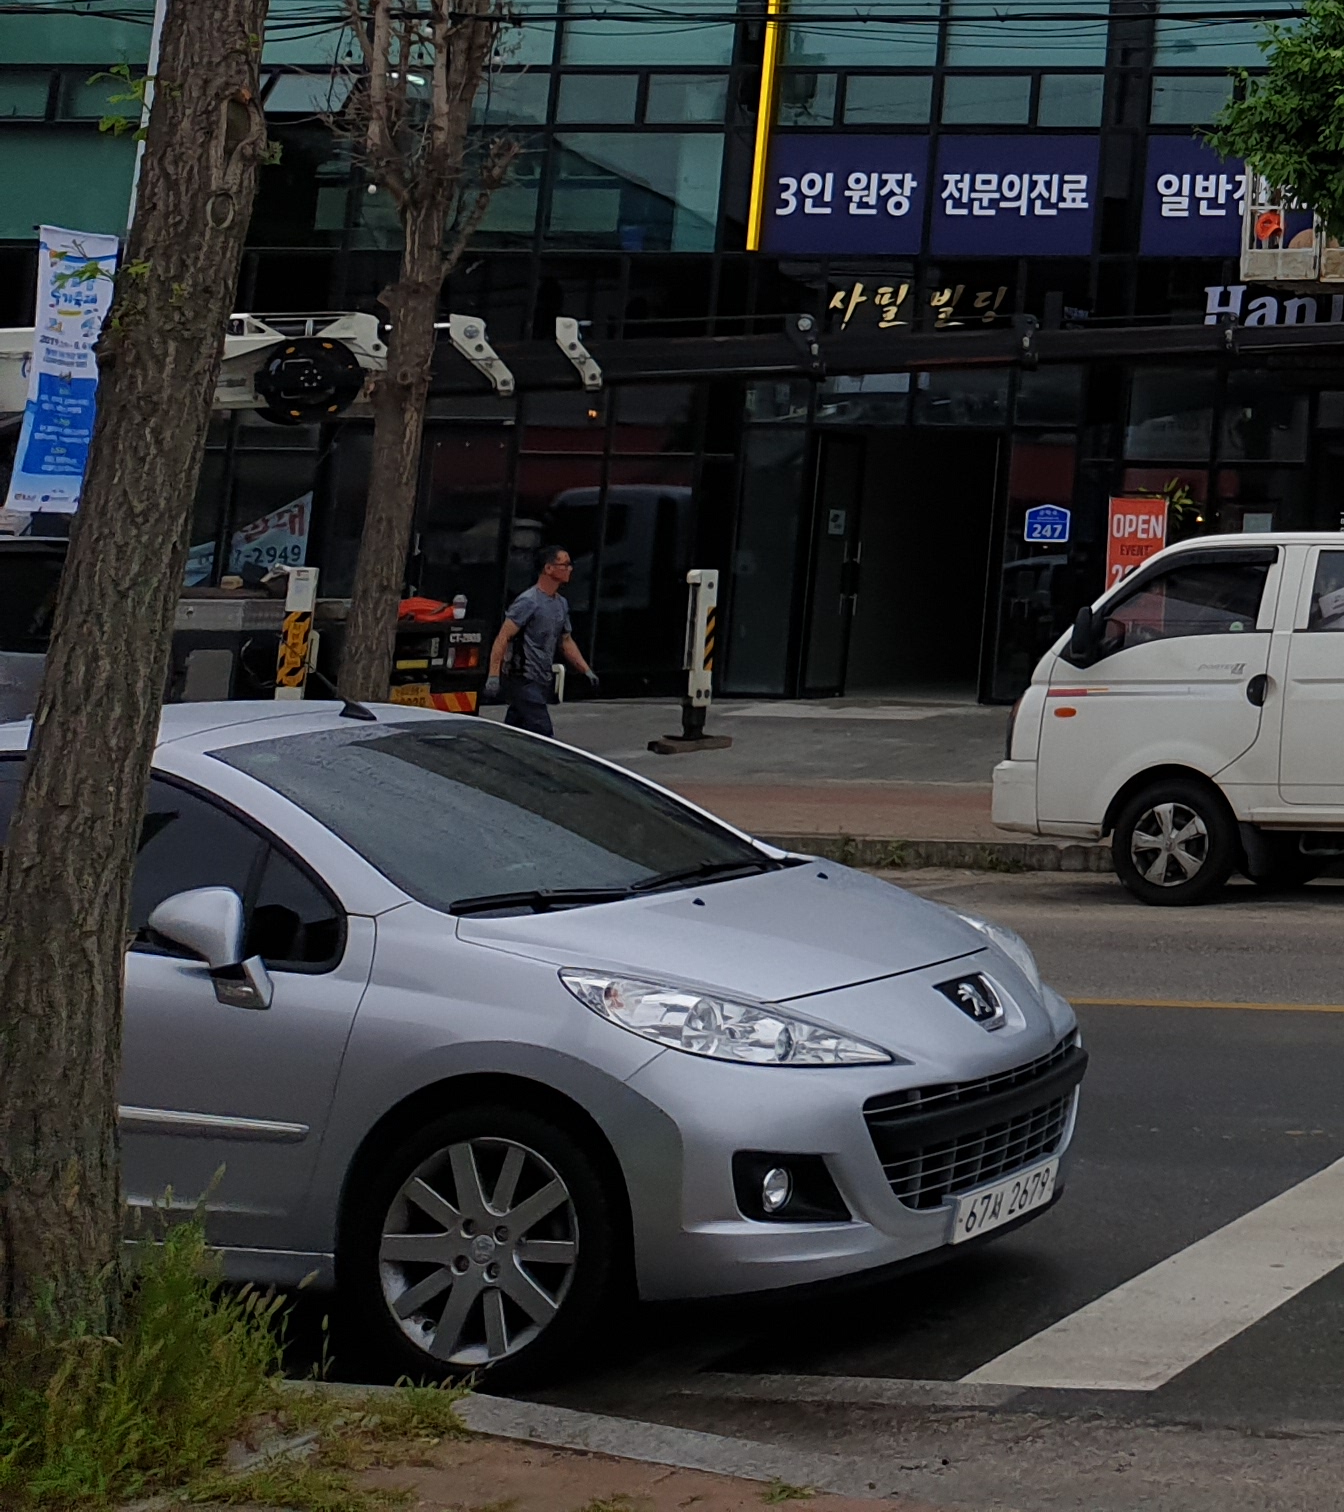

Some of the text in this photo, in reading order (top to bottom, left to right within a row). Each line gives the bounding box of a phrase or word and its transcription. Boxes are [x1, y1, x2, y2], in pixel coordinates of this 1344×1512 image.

[775, 172, 919, 217] 3인 원장
[940, 172, 1090, 217] 전문의진료
[1031, 523, 1063, 538] 247
[1112, 513, 1163, 538] OPEN
[1007, 1167, 1051, 1216] 2679
